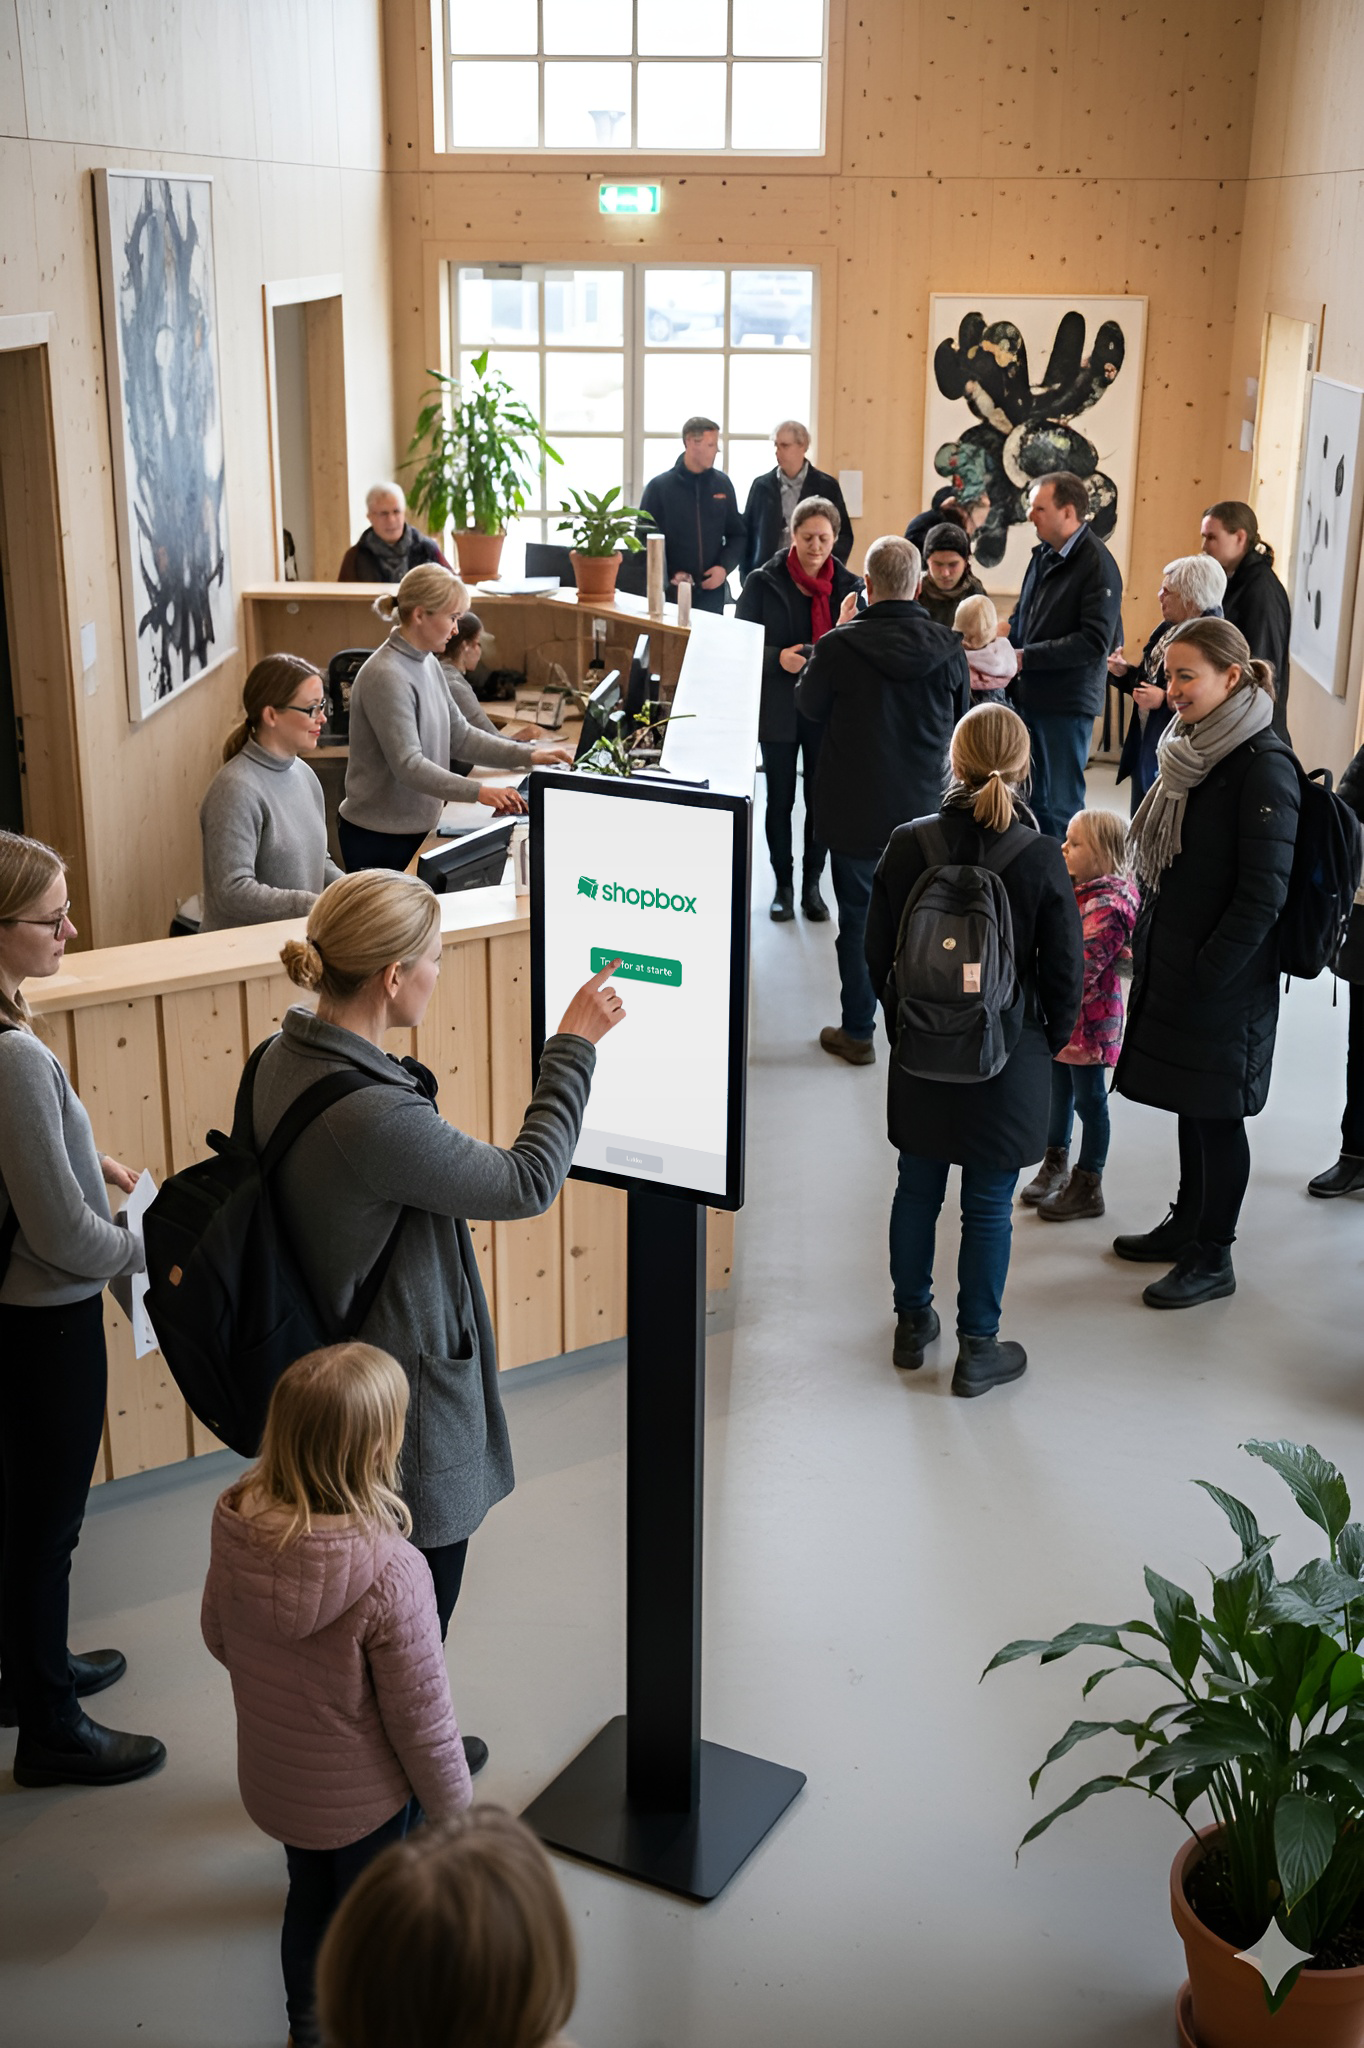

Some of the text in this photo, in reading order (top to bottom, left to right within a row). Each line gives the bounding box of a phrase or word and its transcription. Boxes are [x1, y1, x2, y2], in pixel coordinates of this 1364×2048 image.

[602, 882, 697, 914] shopbox
[621, 960, 633, 970] for
[635, 964, 644, 972] at
[647, 966, 673, 976] starte
